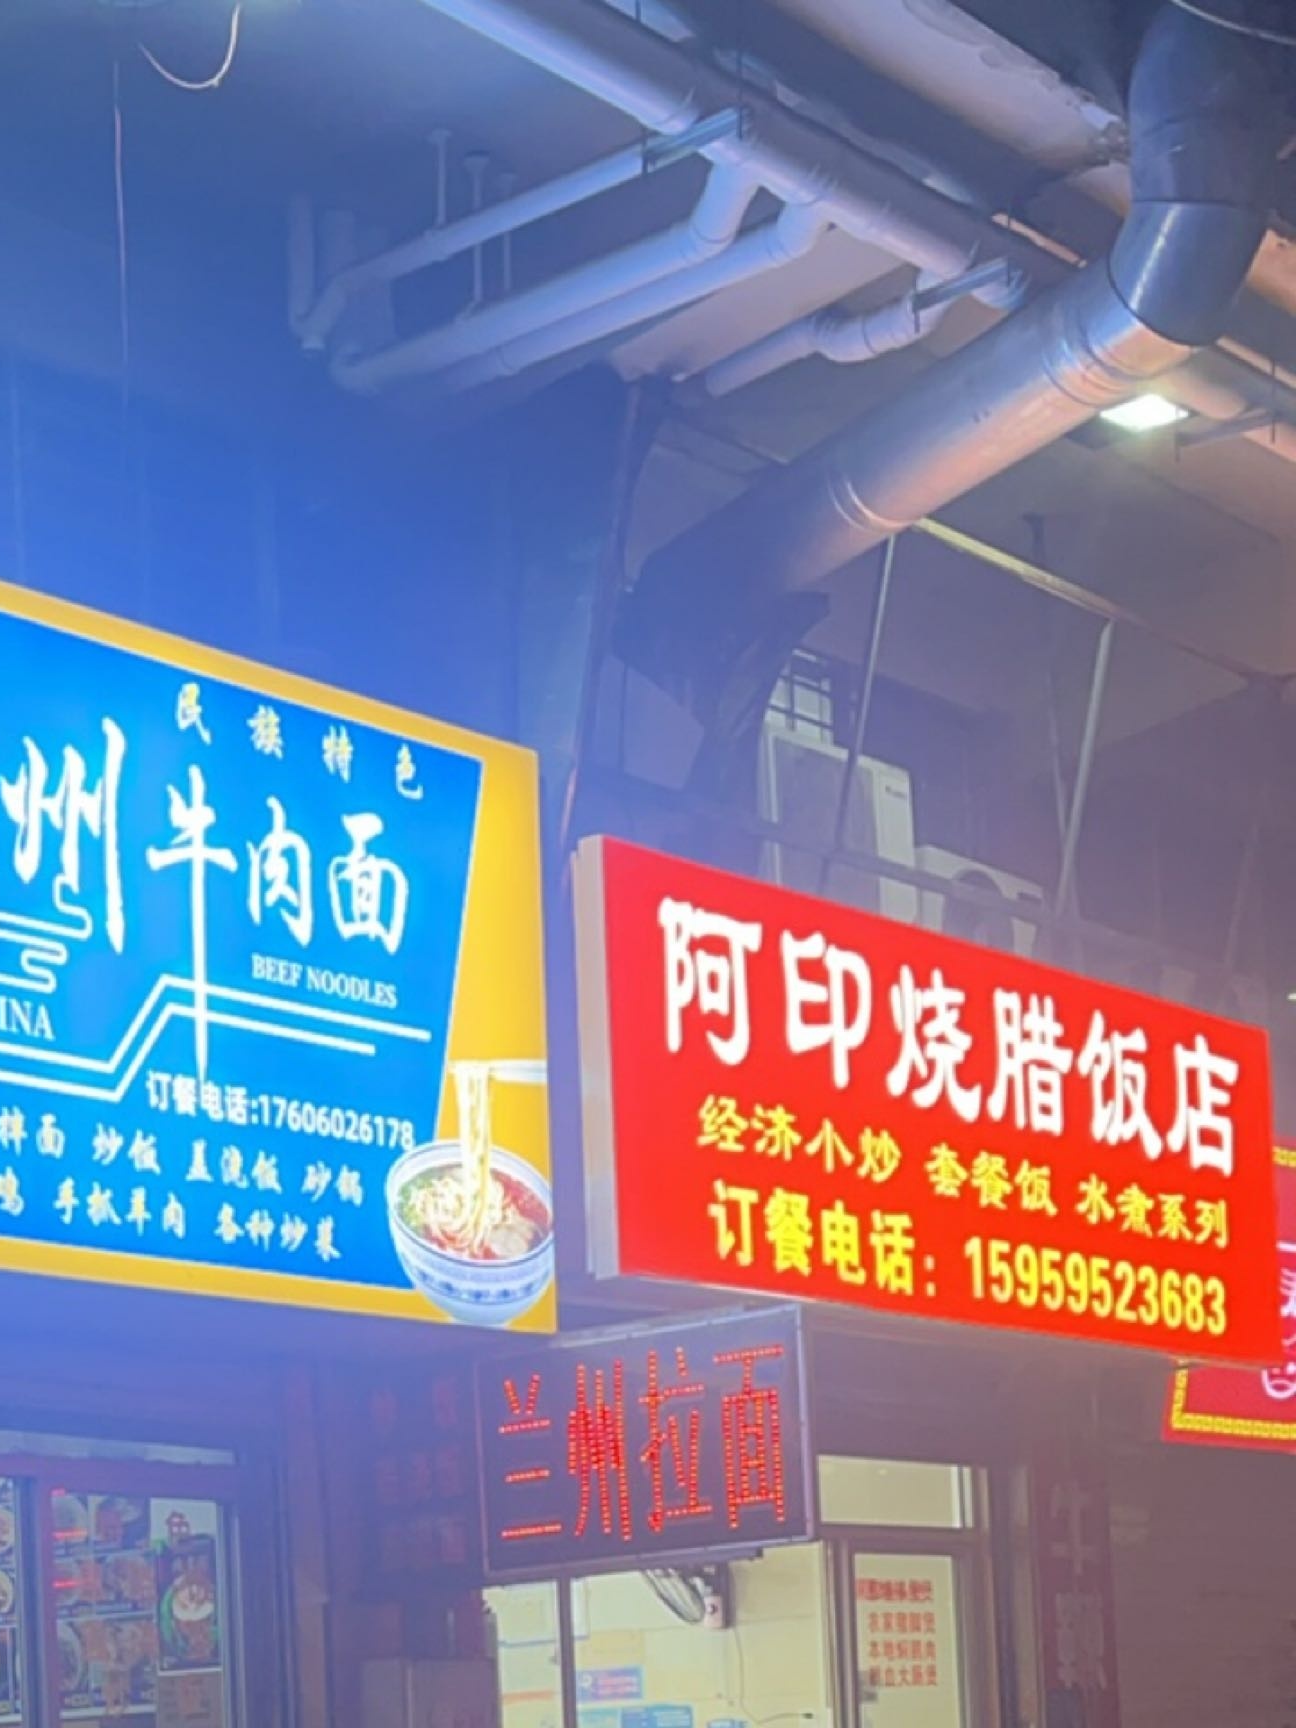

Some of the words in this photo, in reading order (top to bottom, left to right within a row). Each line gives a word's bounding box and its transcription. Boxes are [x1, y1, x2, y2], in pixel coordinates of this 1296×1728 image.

[175, 682, 424, 800] 民族特色
[147, 764, 410, 1078] 牛肉面
[251, 952, 304, 985] BEEF
[305, 967, 398, 1010] NOODLES
[658, 896, 1240, 1177] 阿印烧腊饭店
[696, 1093, 903, 1184] 经济小炒
[923, 1143, 1057, 1217] 套餐饭
[1076, 1175, 1230, 1250] 水煮系列
[498, 1343, 788, 1542] 兰州拉面
